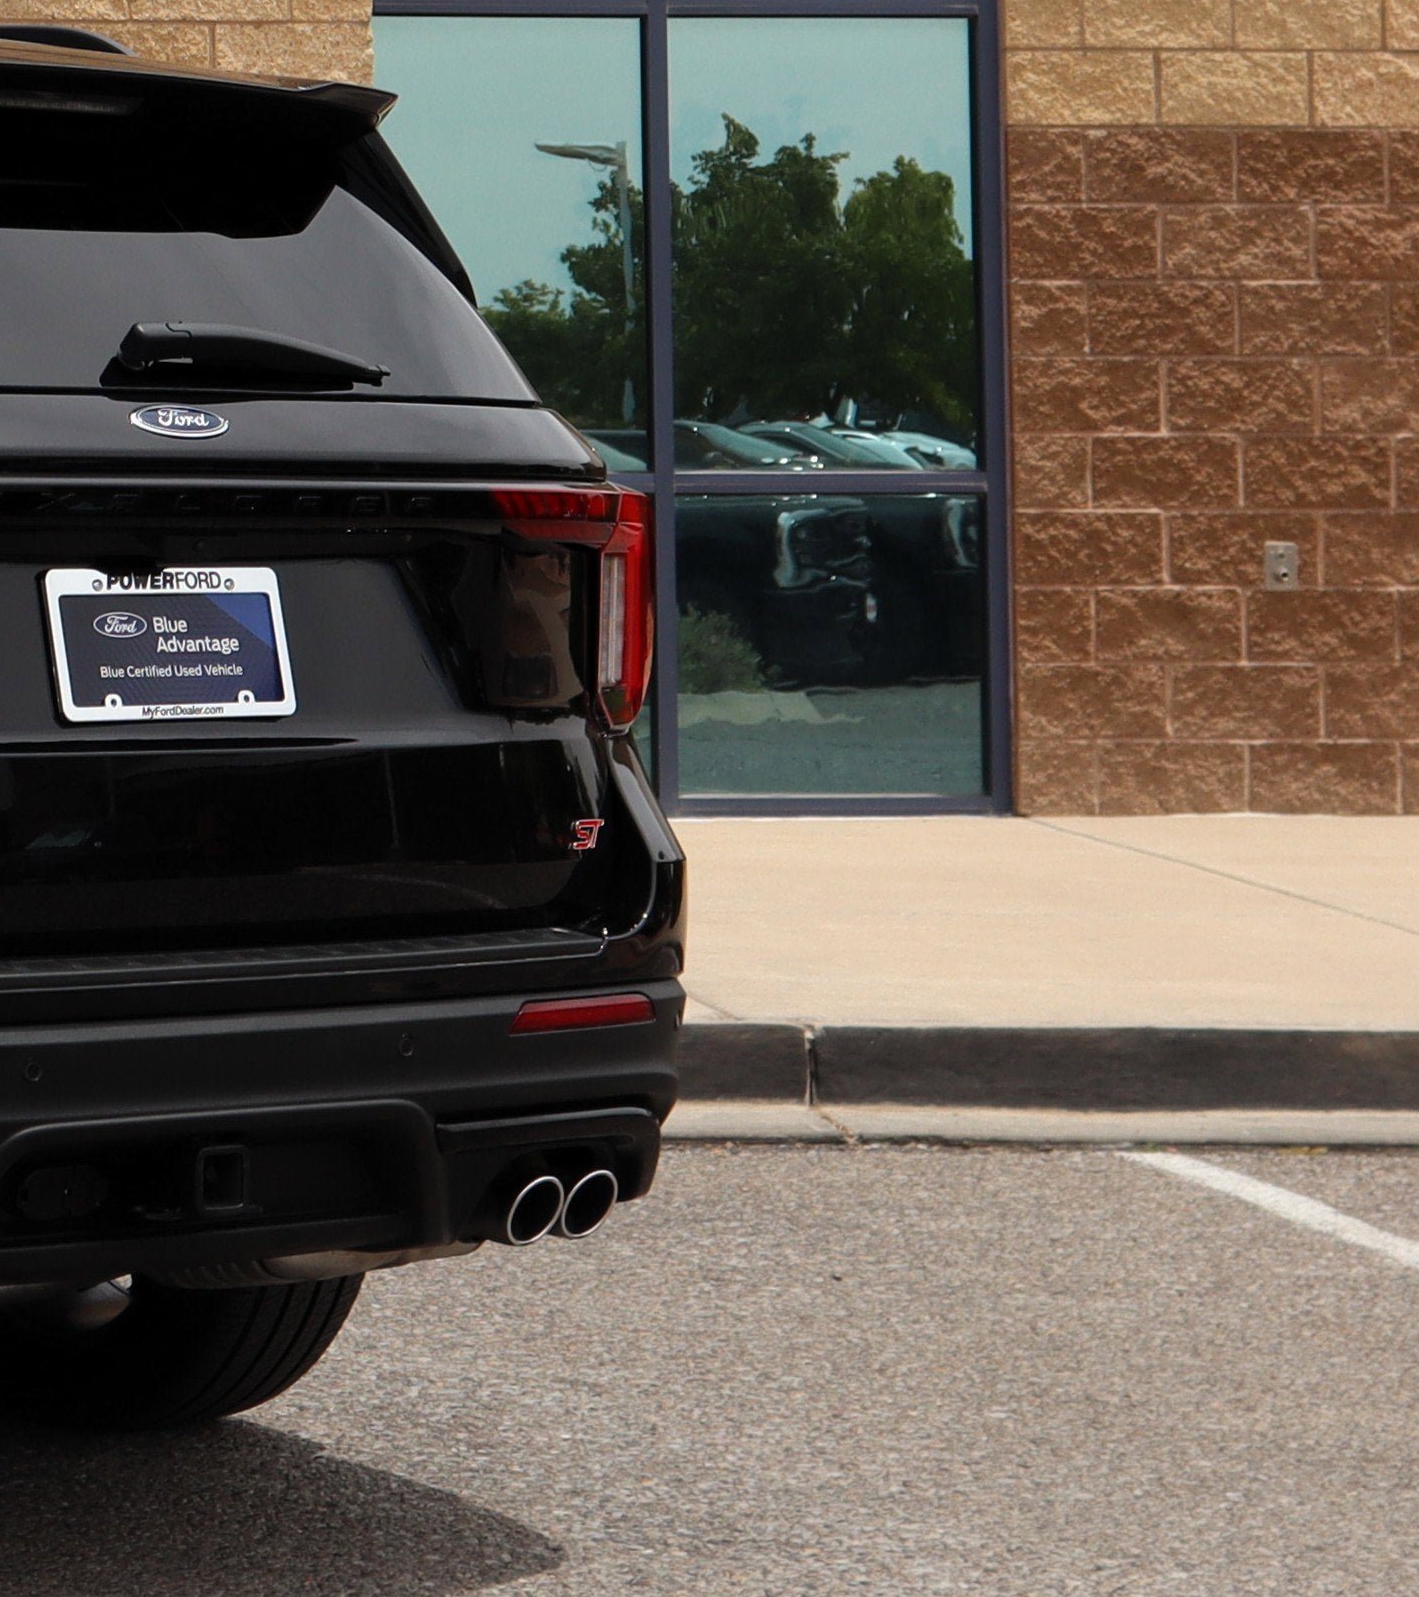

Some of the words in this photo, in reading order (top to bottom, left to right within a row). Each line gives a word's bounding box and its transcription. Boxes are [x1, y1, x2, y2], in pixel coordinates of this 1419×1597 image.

[157, 408, 209, 427] Ford
[106, 571, 221, 590] POWERFORD
[104, 616, 137, 634] Ford
[153, 617, 188, 634] Blue
[157, 636, 240, 655] Advantage
[100, 665, 125, 678] Blue
[126, 664, 172, 678] Certified
[174, 664, 202, 677] Used
[205, 664, 243, 676] Vehicle
[142, 705, 224, 719] MyFordDealer.com
[573, 819, 604, 850] ST
